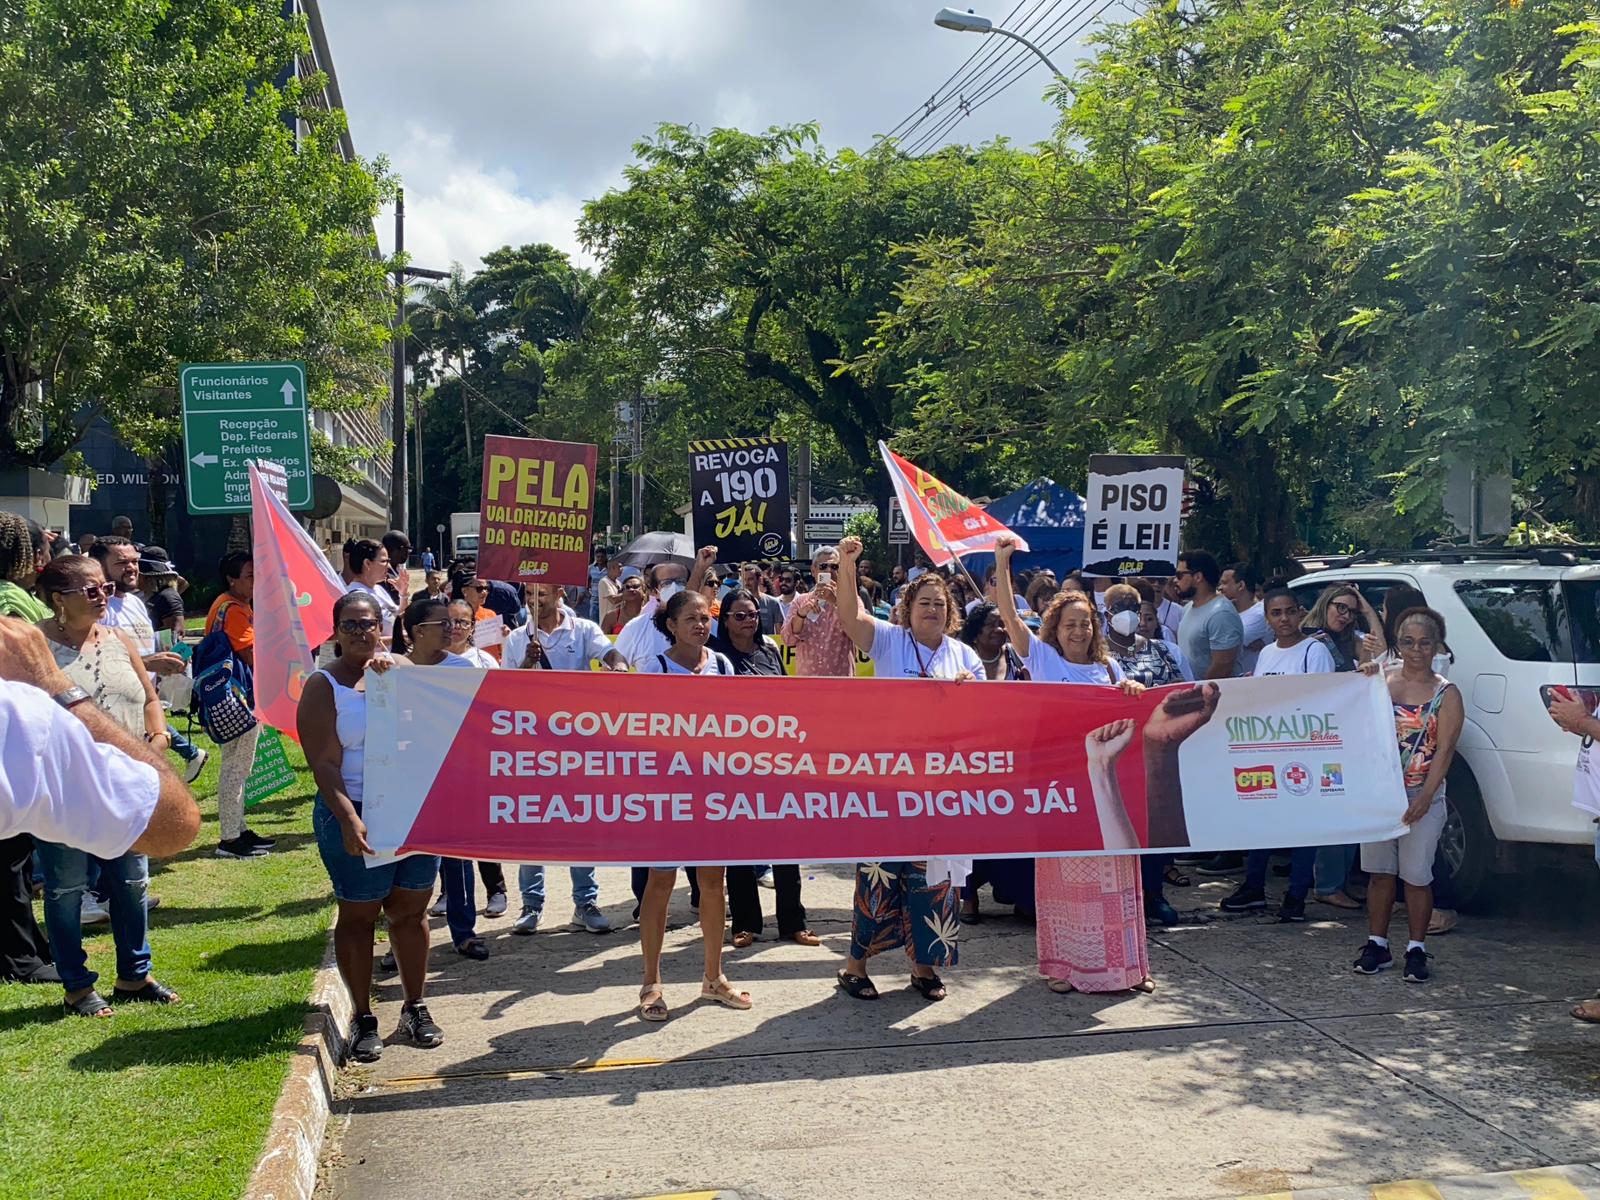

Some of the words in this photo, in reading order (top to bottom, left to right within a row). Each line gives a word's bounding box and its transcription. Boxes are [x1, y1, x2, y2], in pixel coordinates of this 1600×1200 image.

[191, 376, 269, 387] Funcionários
[193, 390, 252, 400] Visitantes
[220, 419, 278, 431] Recepção
[221, 432, 247, 442] Dep.
[250, 430, 298, 440] Federais
[222, 445, 272, 454] Prefeitos
[695, 447, 780, 471] REVOGA
[223, 458, 240, 468] Ex.
[96, 473, 119, 485] ED.
[121, 473, 180, 485] WILON
[487, 454, 589, 510] PELA
[700, 490, 715, 506] A
[715, 467, 778, 503] 190
[1101, 483, 1168, 512] PISO
[715, 498, 768, 538] JÁ!
[485, 528, 505, 545] DA
[510, 530, 584, 552] CARREIRA
[1091, 518, 1108, 550] É
[1119, 523, 1171, 550] LEI!
[518, 560, 549, 573] APLB
[490, 710, 537, 736] SR
[548, 711, 808, 743] GOVERNADOR,
[1225, 708, 1339, 742] SINDSAÚDE
[259, 736, 278, 749] COM
[489, 750, 658, 777] RESPEITE
[667, 751, 693, 776] A
[703, 751, 817, 776] NOSSA
[827, 752, 916, 775] DATA
[925, 750, 1014, 775] BASE!
[1237, 771, 1275, 788] CTB
[489, 793, 694, 824] REAJUSTE
[705, 792, 889, 821] SALARIAL
[897, 789, 1014, 818] DIGNO
[1023, 780, 1078, 815] JÁ!
